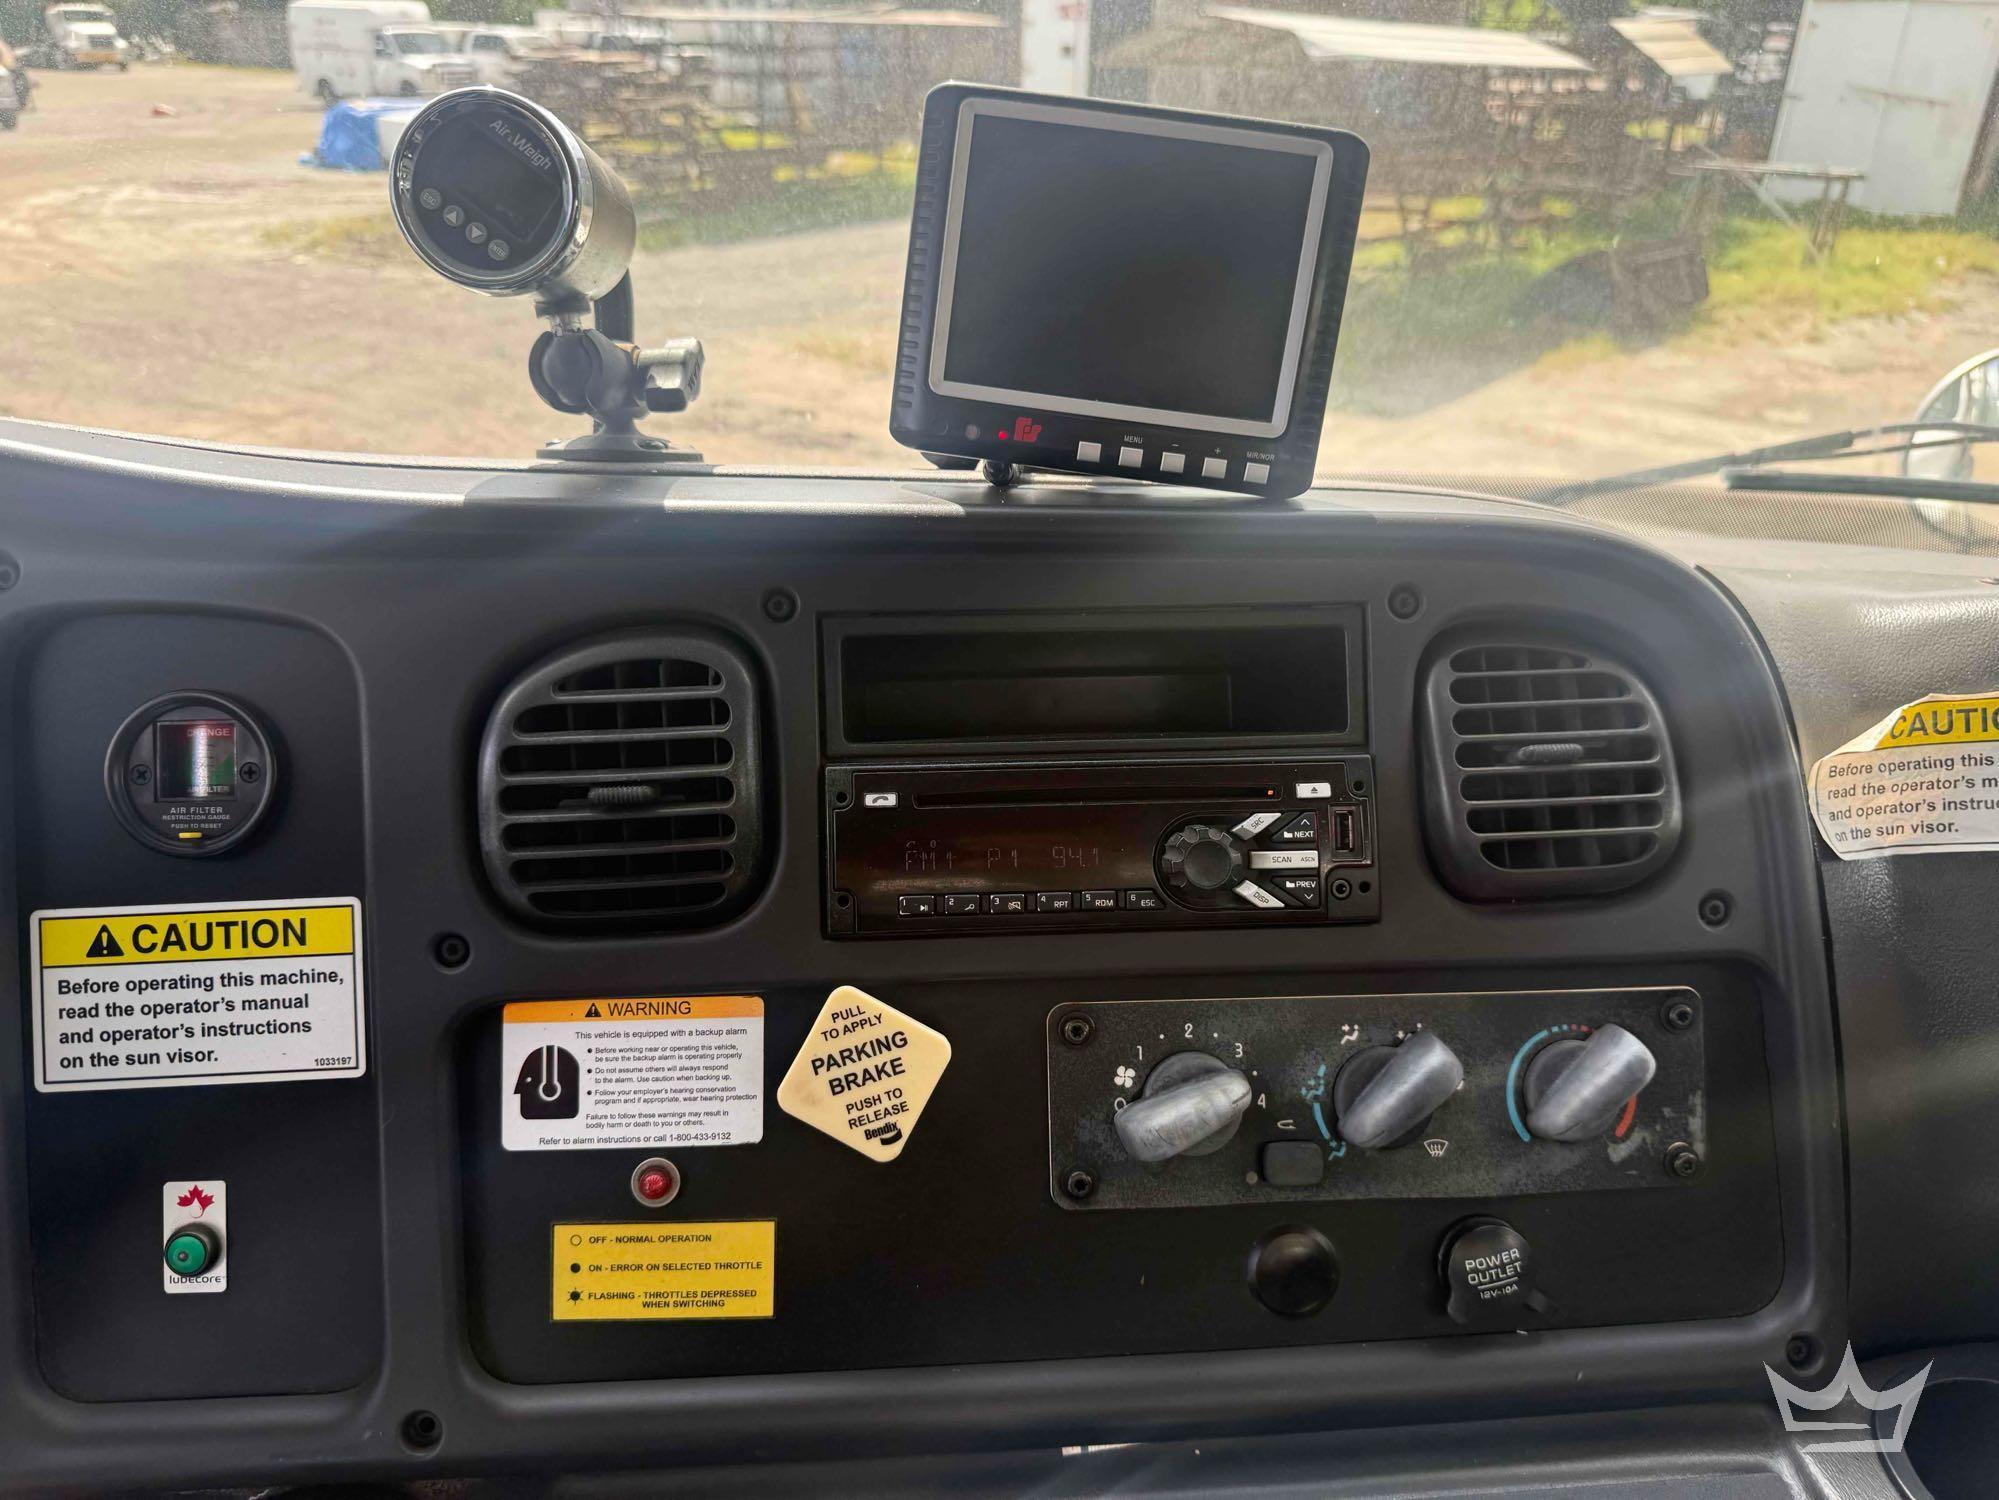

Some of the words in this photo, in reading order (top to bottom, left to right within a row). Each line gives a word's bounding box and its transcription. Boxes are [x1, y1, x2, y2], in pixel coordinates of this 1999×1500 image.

[422, 192, 437, 206] ESC
[1123, 435, 1144, 444] MENU
[1246, 452, 1276, 461] MIR/NOR
[187, 728, 231, 737] CNGE
[1828, 763, 1873, 779] Before
[1878, 756, 1955, 776] operating
[1960, 753, 1994, 767] this
[1828, 784, 1856, 800] read
[1862, 782, 1886, 796] the
[1891, 775, 1976, 796] operator's
[1829, 806, 1852, 822] and
[1856, 799, 1936, 820] operator's
[1251, 817, 1265, 829] SRC
[1835, 830, 1847, 842] on
[1850, 825, 1871, 840] the
[1876, 821, 1904, 837] sun
[1911, 820, 1959, 834] visor.
[1295, 880, 1316, 888] PREV
[1054, 900, 1068, 908] RPT
[1141, 899, 1156, 907] ESC
[1253, 891, 1270, 904] DISP
[132, 918, 307, 955] CAUTION
[58, 979, 120, 995] Before
[126, 976, 214, 995] operating
[220, 973, 254, 988] this
[260, 969, 344, 989] machine,
[58, 1003, 100, 1020] read
[105, 1002, 135, 1018] the
[140, 997, 236, 1020] operator's
[241, 994, 309, 1012] manual
[608, 1001, 692, 1017] WARNING
[831, 1005, 866, 1023] PULL
[59, 1028, 93, 1044] and
[99, 1024, 195, 1045] operator's
[201, 1019, 312, 1038] instructions
[575, 1031, 592, 1039] This
[624, 1030, 630, 1038] is
[632, 1030, 668, 1039] equipped
[695, 1028, 724, 1037] backup
[821, 1028, 839, 1042] TO
[843, 1013, 883, 1036] APPLY
[1184, 1023, 1193, 1038] 2
[60, 1054, 84, 1068] on
[90, 1051, 120, 1067] the
[126, 1051, 160, 1065] sun
[167, 1047, 218, 1064] visor.
[685, 1052, 714, 1061] operating
[716, 1052, 742, 1060] properly
[811, 1031, 908, 1076] PARKING
[1136, 1045, 1143, 1060] 1
[1234, 1042, 1243, 1058] 3
[314, 1056, 352, 1067] 1033197
[828, 1057, 906, 1096] BRAKE
[633, 1088, 668, 1096] employer's
[595, 1098, 622, 1106] program
[643, 1096, 681, 1104] appropriate,
[846, 1093, 882, 1114] PUSH
[884, 1088, 902, 1101] TO
[1258, 1093, 1266, 1109] 4
[848, 1101, 910, 1130] RELEASE
[539, 1137, 561, 1145] Refer
[563, 1137, 571, 1145] to
[597, 1136, 641, 1144] instructions
[654, 1134, 667, 1142] call
[669, 1132, 732, 1141] 1-800-433-9132
[864, 1122, 898, 1141] Bendix
[588, 1236, 607, 1244] OFF
[615, 1235, 656, 1243] NORMAL
[658, 1234, 712, 1243] OPERATION
[588, 1264, 602, 1272] ON
[610, 1264, 643, 1272] ERROR
[646, 1263, 660, 1271] ON
[662, 1262, 711, 1271] SELECTED
[714, 1262, 763, 1270] THROTTLE
[1465, 1248, 1520, 1271] POWER
[1468, 1261, 1522, 1284] OUTLET
[588, 1292, 635, 1300] FLASHING
[644, 1290, 698, 1299] THROTTLES
[700, 1290, 757, 1298] DEPRESSED
[1480, 1284, 1518, 1299] 12V-10A
[642, 1300, 670, 1308] WHEN
[673, 1300, 725, 1308] SWITCHING
